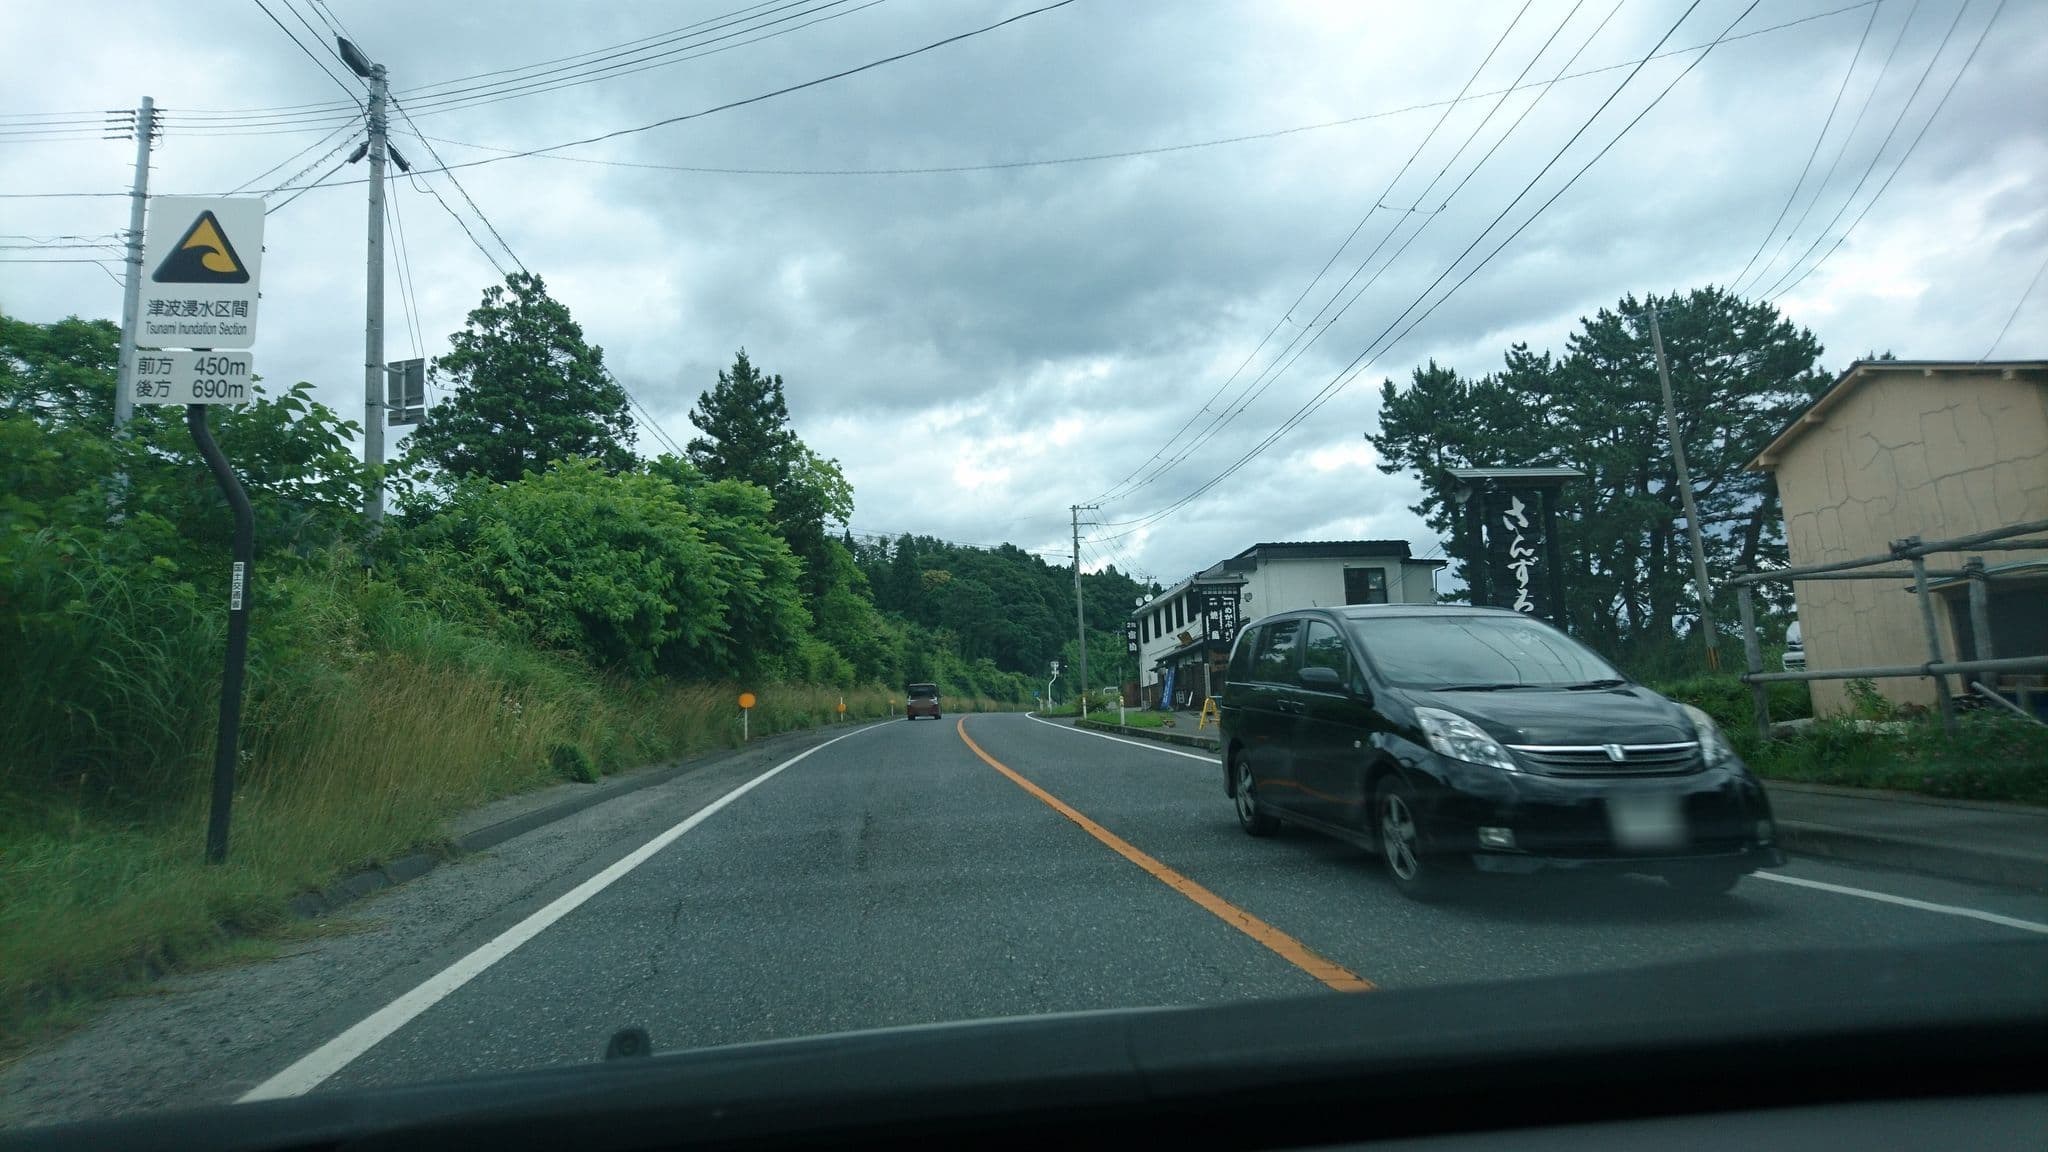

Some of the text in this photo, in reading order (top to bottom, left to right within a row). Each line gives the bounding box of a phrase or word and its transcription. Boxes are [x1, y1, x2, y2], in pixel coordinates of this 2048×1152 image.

[146, 300, 249, 318] 津波浸水区間
[146, 321, 247, 335] Tsunami Inundation Section
[137, 356, 246, 376] 前方 450m
[135, 379, 244, 398] 後方 690m
